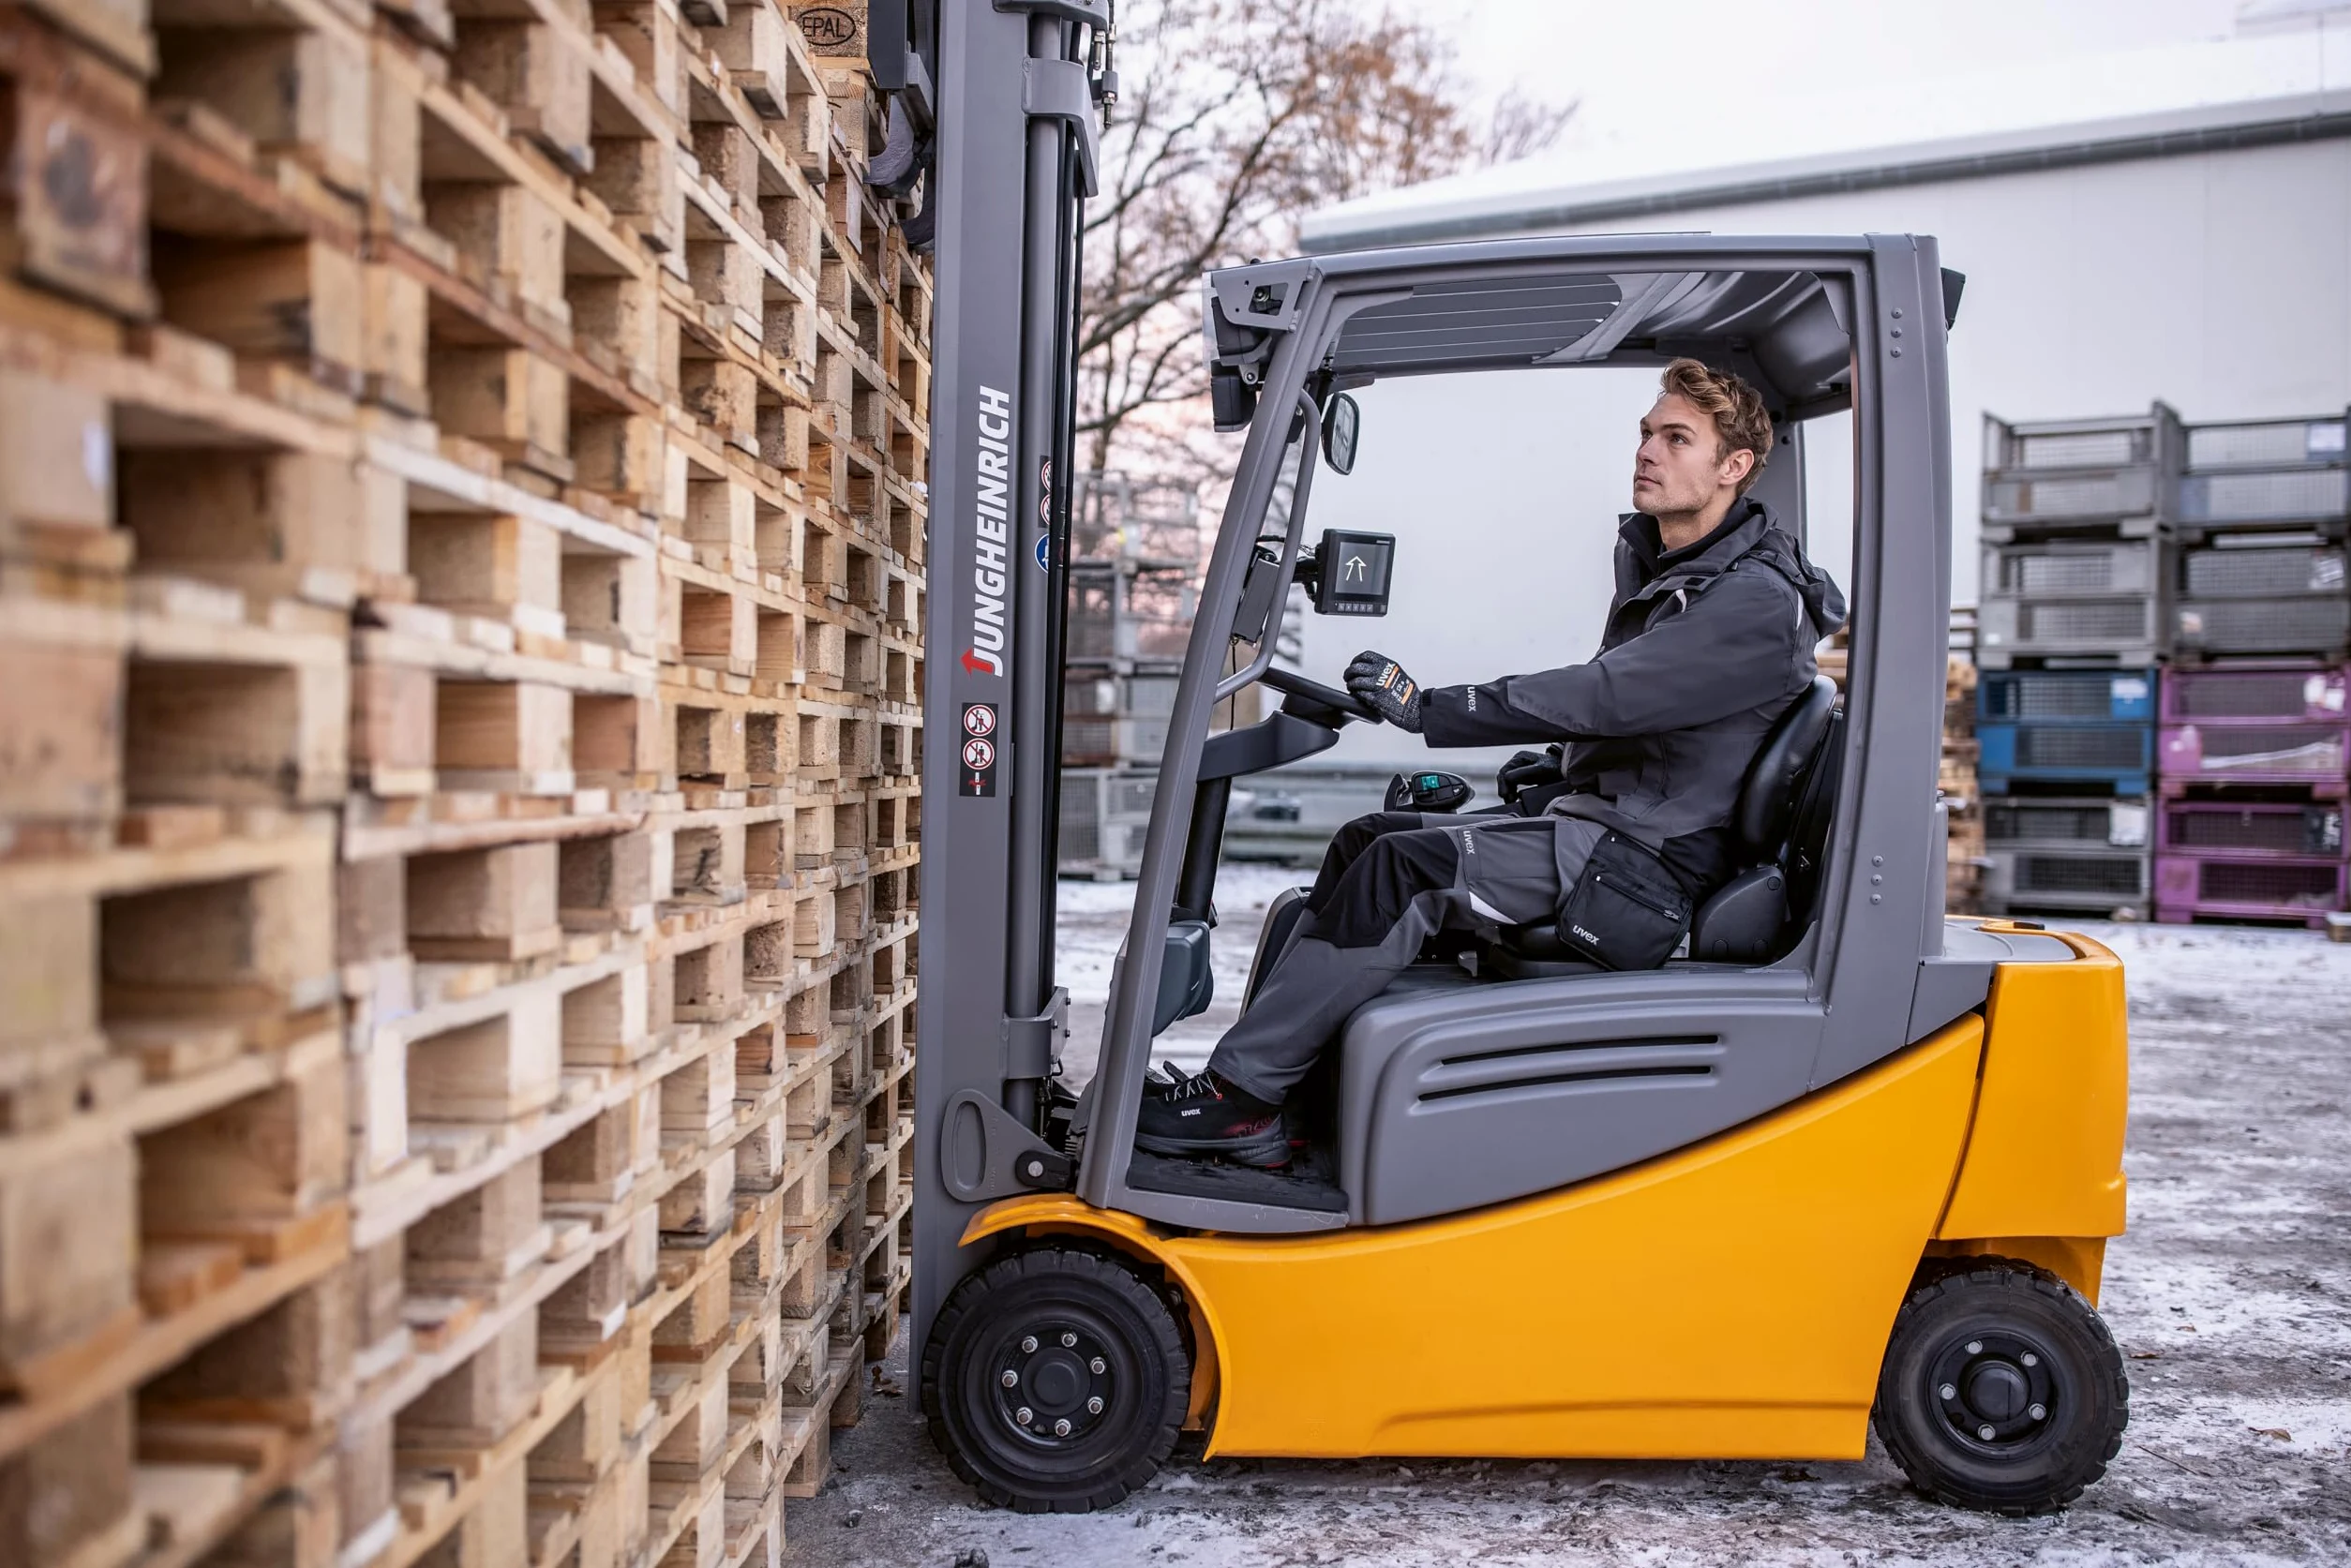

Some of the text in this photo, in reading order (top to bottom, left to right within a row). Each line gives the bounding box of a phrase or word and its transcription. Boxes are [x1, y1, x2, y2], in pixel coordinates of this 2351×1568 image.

[801, 17, 846, 38] EPAL
[972, 385, 1010, 678] JUNGHEINRICH
[1376, 662, 1397, 687] uvex
[1467, 686, 1476, 712] uvex
[1463, 830, 1475, 855] uvex
[1572, 924, 1600, 946] uvex
[1181, 1108, 1201, 1117] uvex
